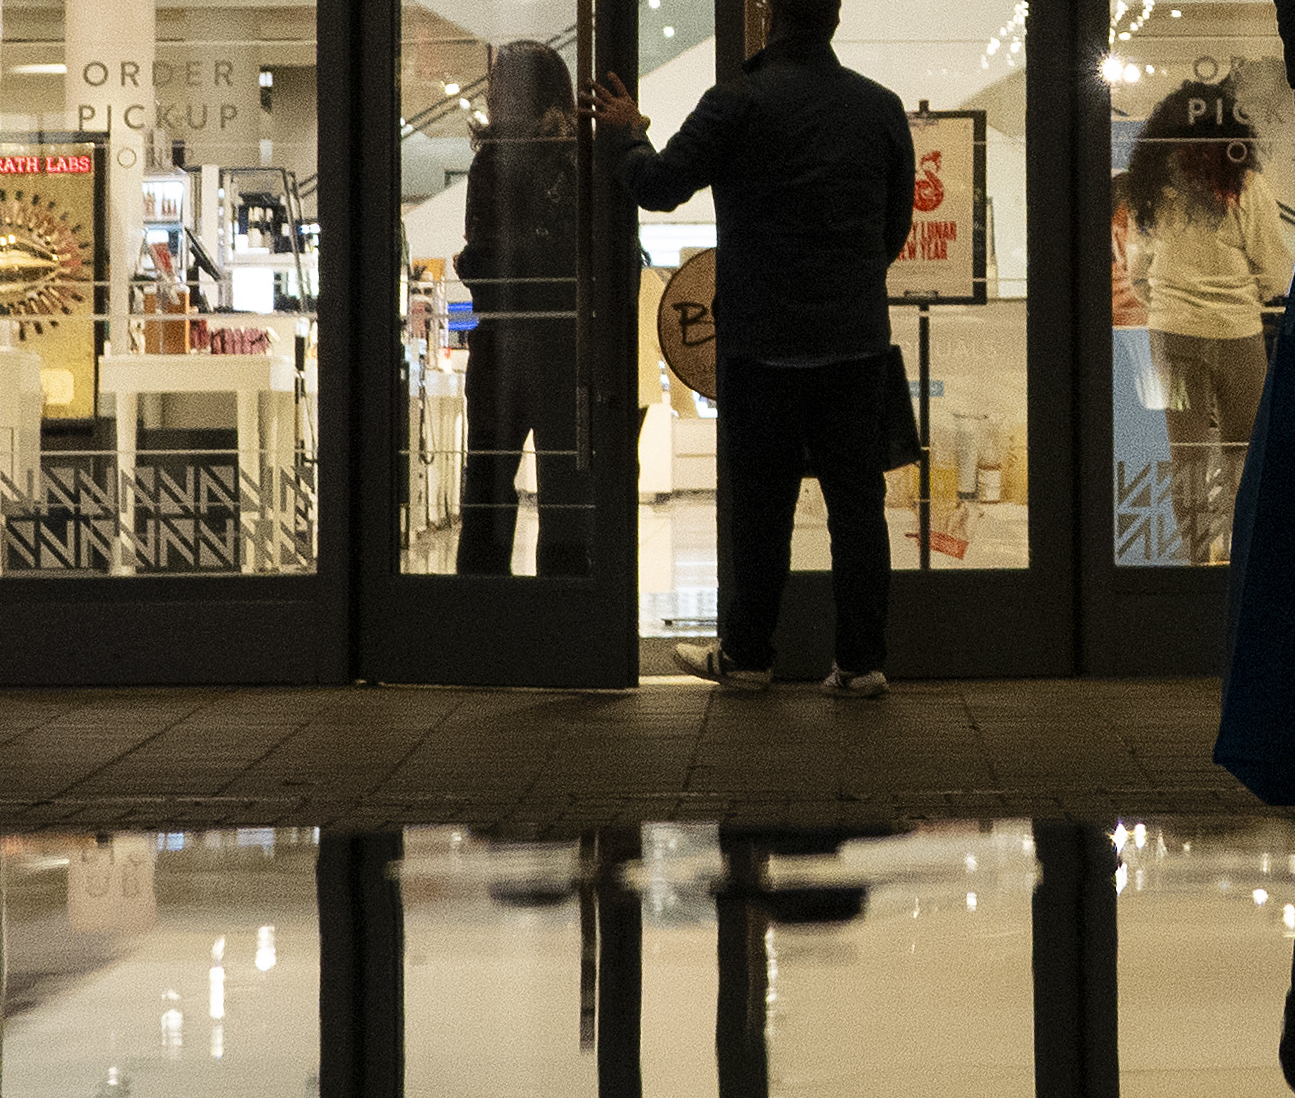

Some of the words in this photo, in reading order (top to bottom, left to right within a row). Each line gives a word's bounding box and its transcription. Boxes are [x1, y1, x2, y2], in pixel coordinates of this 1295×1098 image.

[82, 60, 234, 87] ORDER
[77, 103, 239, 132] PICKUP
[46, 155, 91, 173] LABS
[920, 221, 957, 241] LUNAR
[919, 242, 948, 260] YEAR
